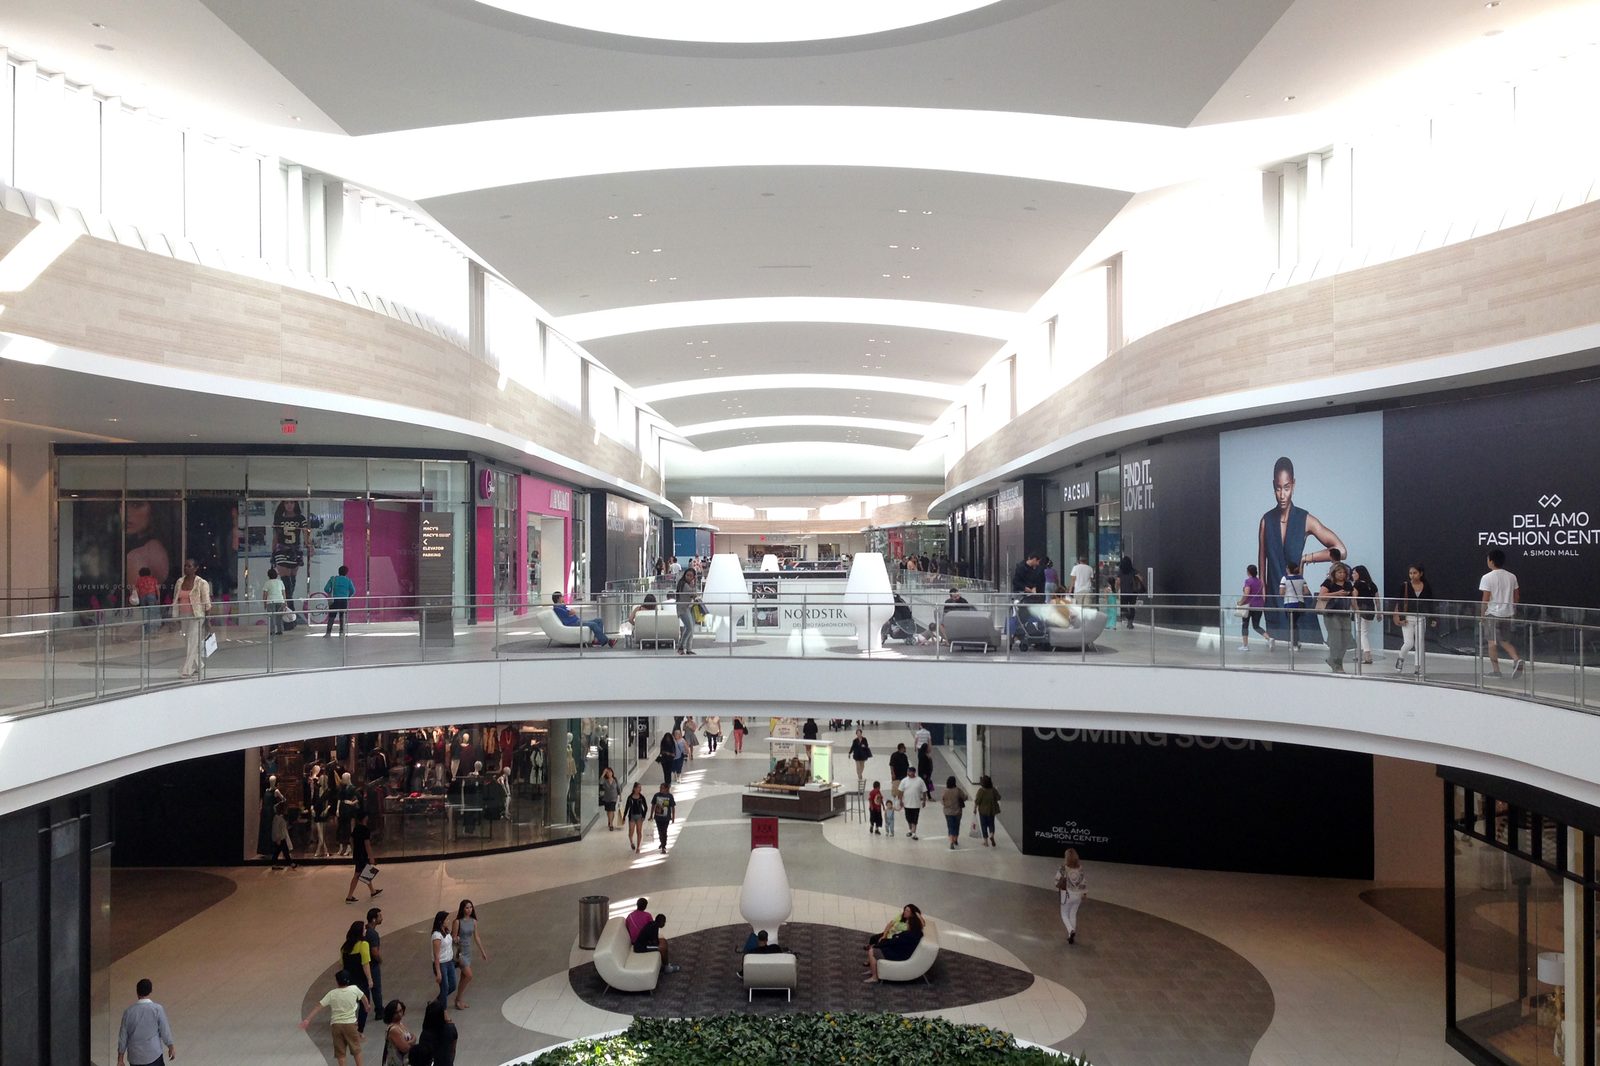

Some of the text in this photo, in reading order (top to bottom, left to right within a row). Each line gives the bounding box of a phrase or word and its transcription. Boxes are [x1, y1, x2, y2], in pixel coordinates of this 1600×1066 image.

[1123, 459, 1152, 487] FIND IT.
[1063, 481, 1090, 502] PACSUN
[1123, 484, 1155, 511] LOVE IT.
[1513, 511, 1590, 528] DEL AMO
[1478, 530, 1550, 546] FASHION
[1530, 549, 1556, 557] SIMON
[1035, 831, 1072, 841] FASHION
[1072, 834, 1109, 843] CENTER
[1052, 826, 1091, 836] DEL AMO
